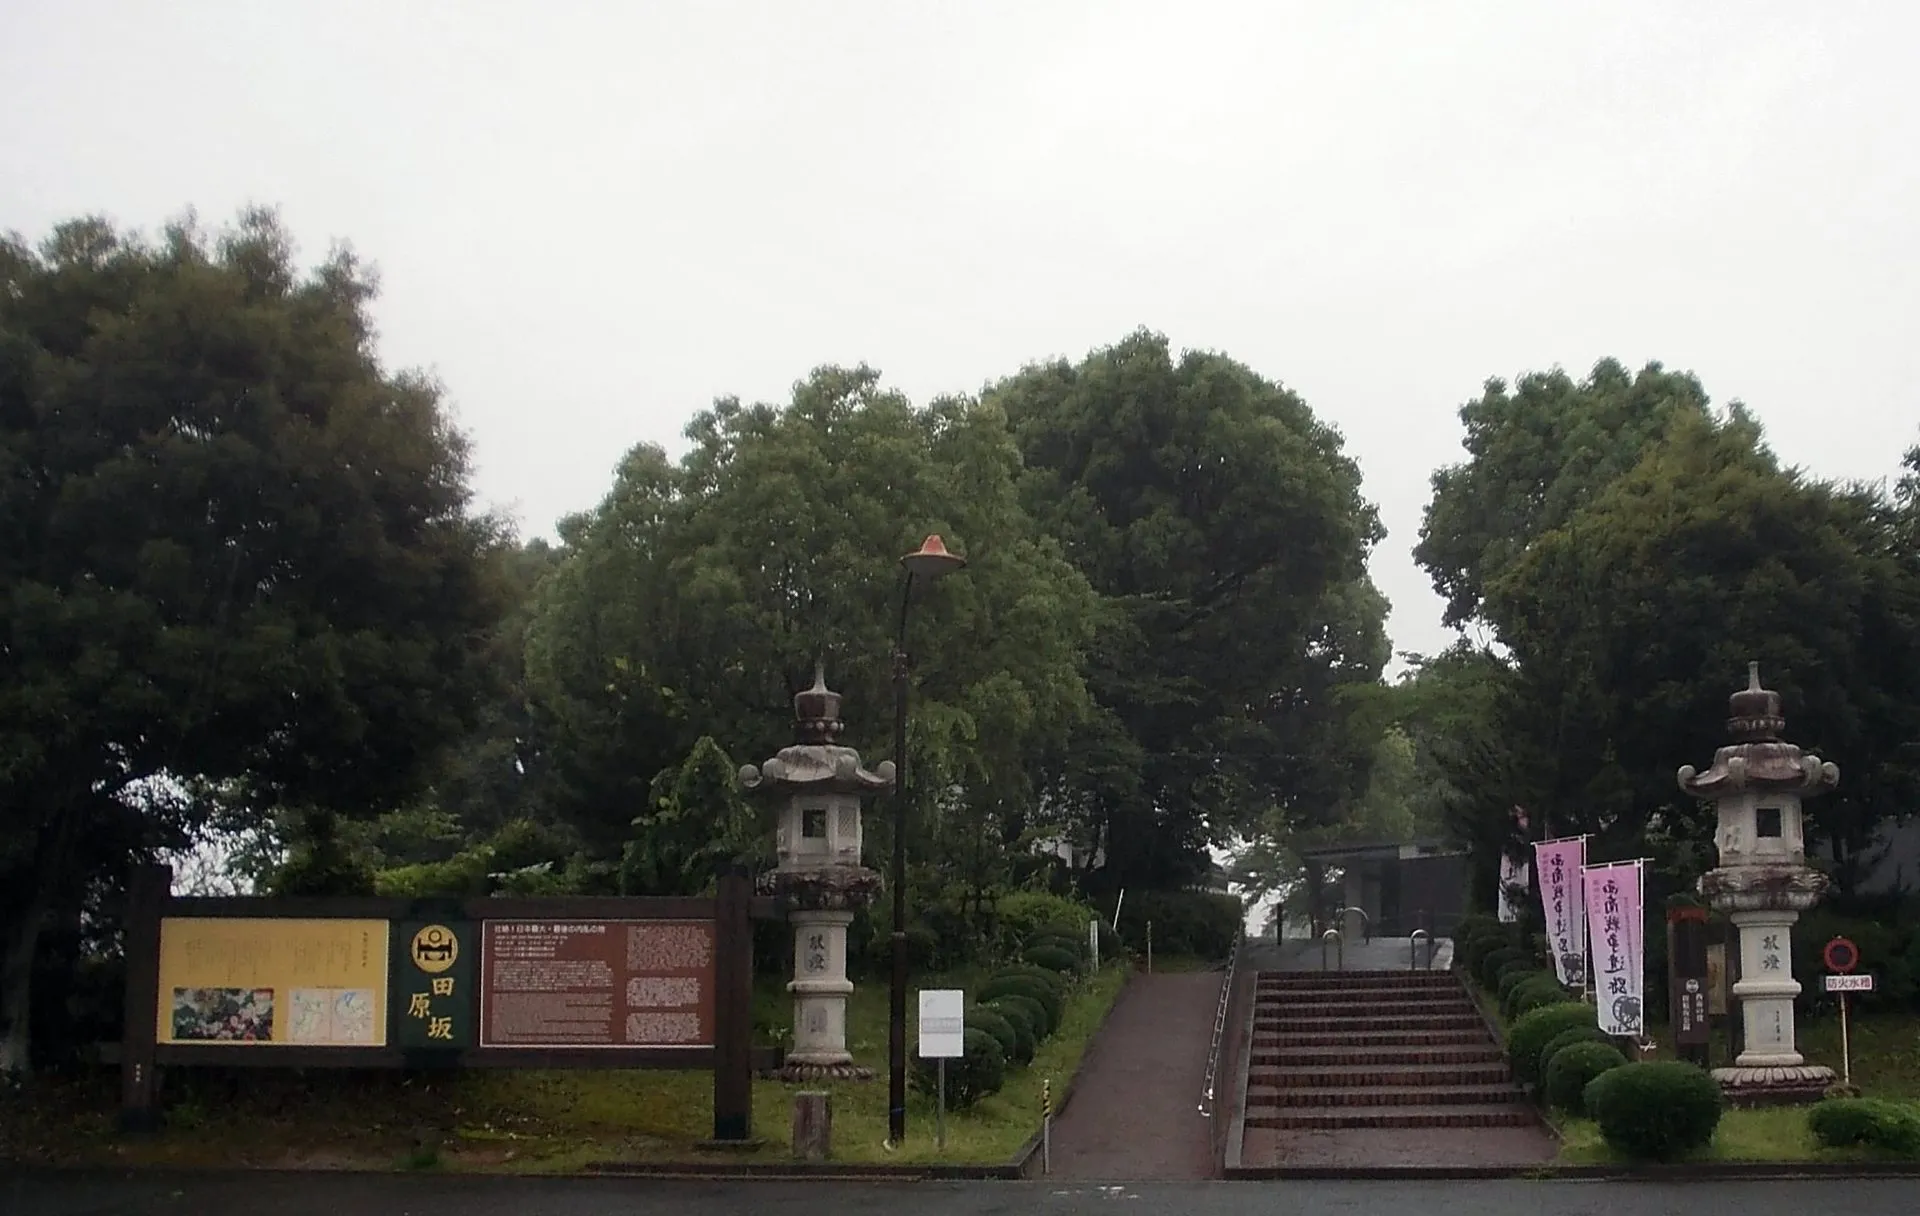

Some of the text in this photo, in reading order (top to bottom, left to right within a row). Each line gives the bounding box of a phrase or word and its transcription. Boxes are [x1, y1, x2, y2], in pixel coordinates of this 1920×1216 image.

[1602, 879, 1628, 995] 西南戦争遺跡
[408, 977, 454, 1039] 田原坂
[1827, 976, 1871, 989] 防火水槽
